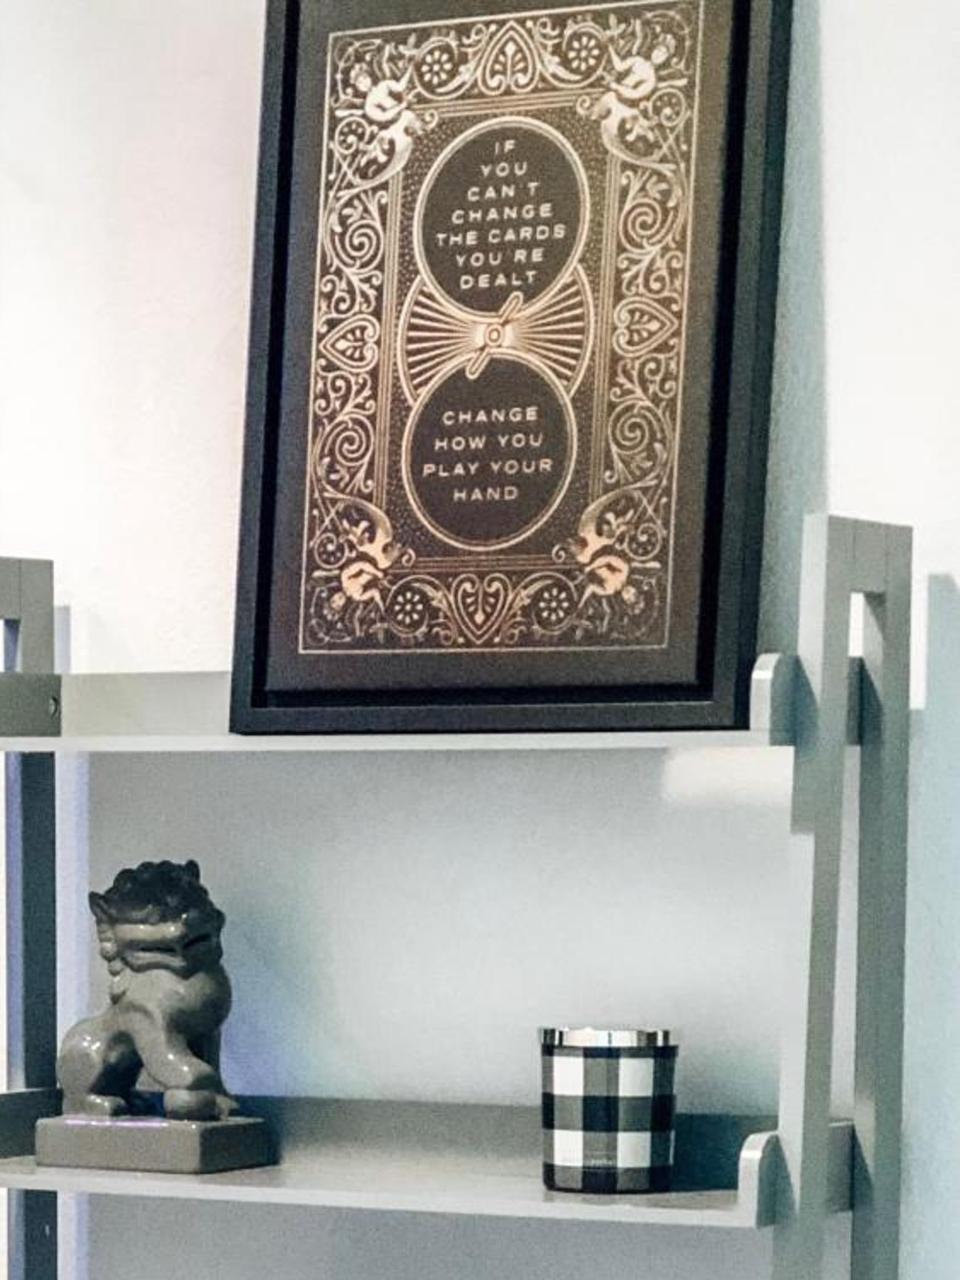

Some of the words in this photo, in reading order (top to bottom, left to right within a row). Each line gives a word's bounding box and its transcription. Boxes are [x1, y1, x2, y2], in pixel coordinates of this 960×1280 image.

[494, 140, 516, 154] IF
[480, 162, 528, 177] YOU
[451, 203, 553, 224] CHANGE
[436, 231, 478, 246] THE
[487, 224, 566, 243] CARDS
[459, 270, 537, 289] DEALT
[441, 406, 539, 425] CHANGE
[434, 436, 487, 450] HOW
[497, 433, 544, 447] YOU
[422, 462, 479, 477] PLAY
[490, 459, 553, 474] YOUR
[453, 486, 519, 501] HAND
